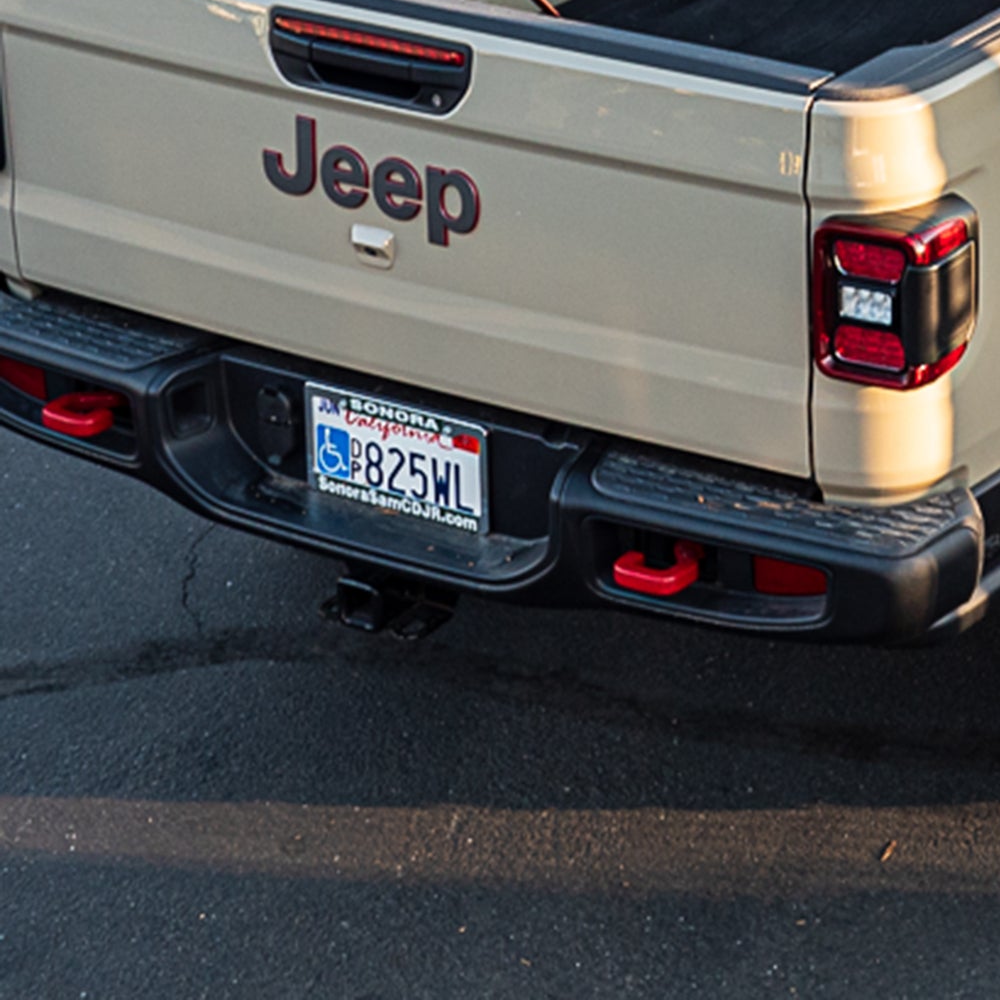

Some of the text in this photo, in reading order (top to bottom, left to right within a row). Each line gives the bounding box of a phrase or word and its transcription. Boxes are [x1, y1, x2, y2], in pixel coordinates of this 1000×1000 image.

[263, 114, 481, 247] Jeep
[350, 399, 439, 431] SONORA
[365, 441, 475, 514] 825WL
